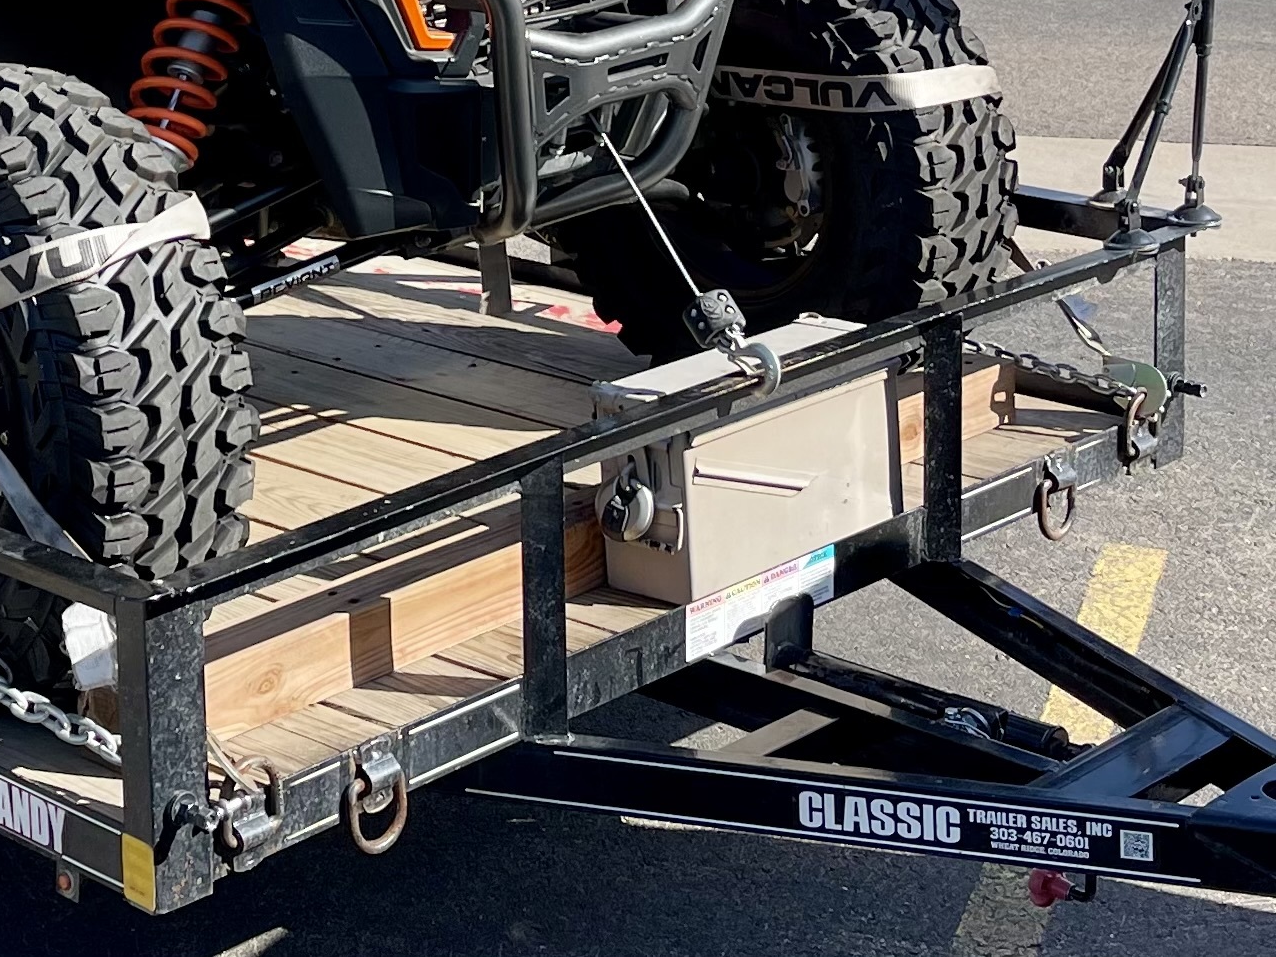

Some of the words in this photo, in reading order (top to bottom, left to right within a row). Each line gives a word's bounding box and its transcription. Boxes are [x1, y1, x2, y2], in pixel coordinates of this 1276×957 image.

[710, 70, 898, 108] VULCAN
[731, 578, 762, 597] CAUTION
[689, 595, 723, 615] WARNING
[798, 791, 961, 844] CLASSIC
[967, 808, 1027, 828] TRAILER
[1030, 816, 1082, 836] SALES,
[1085, 821, 1113, 838] INC
[989, 827, 1090, 850] 303-467-0601
[990, 841, 1020, 851] WHEAT
[1047, 847, 1090, 859] COLORADO
